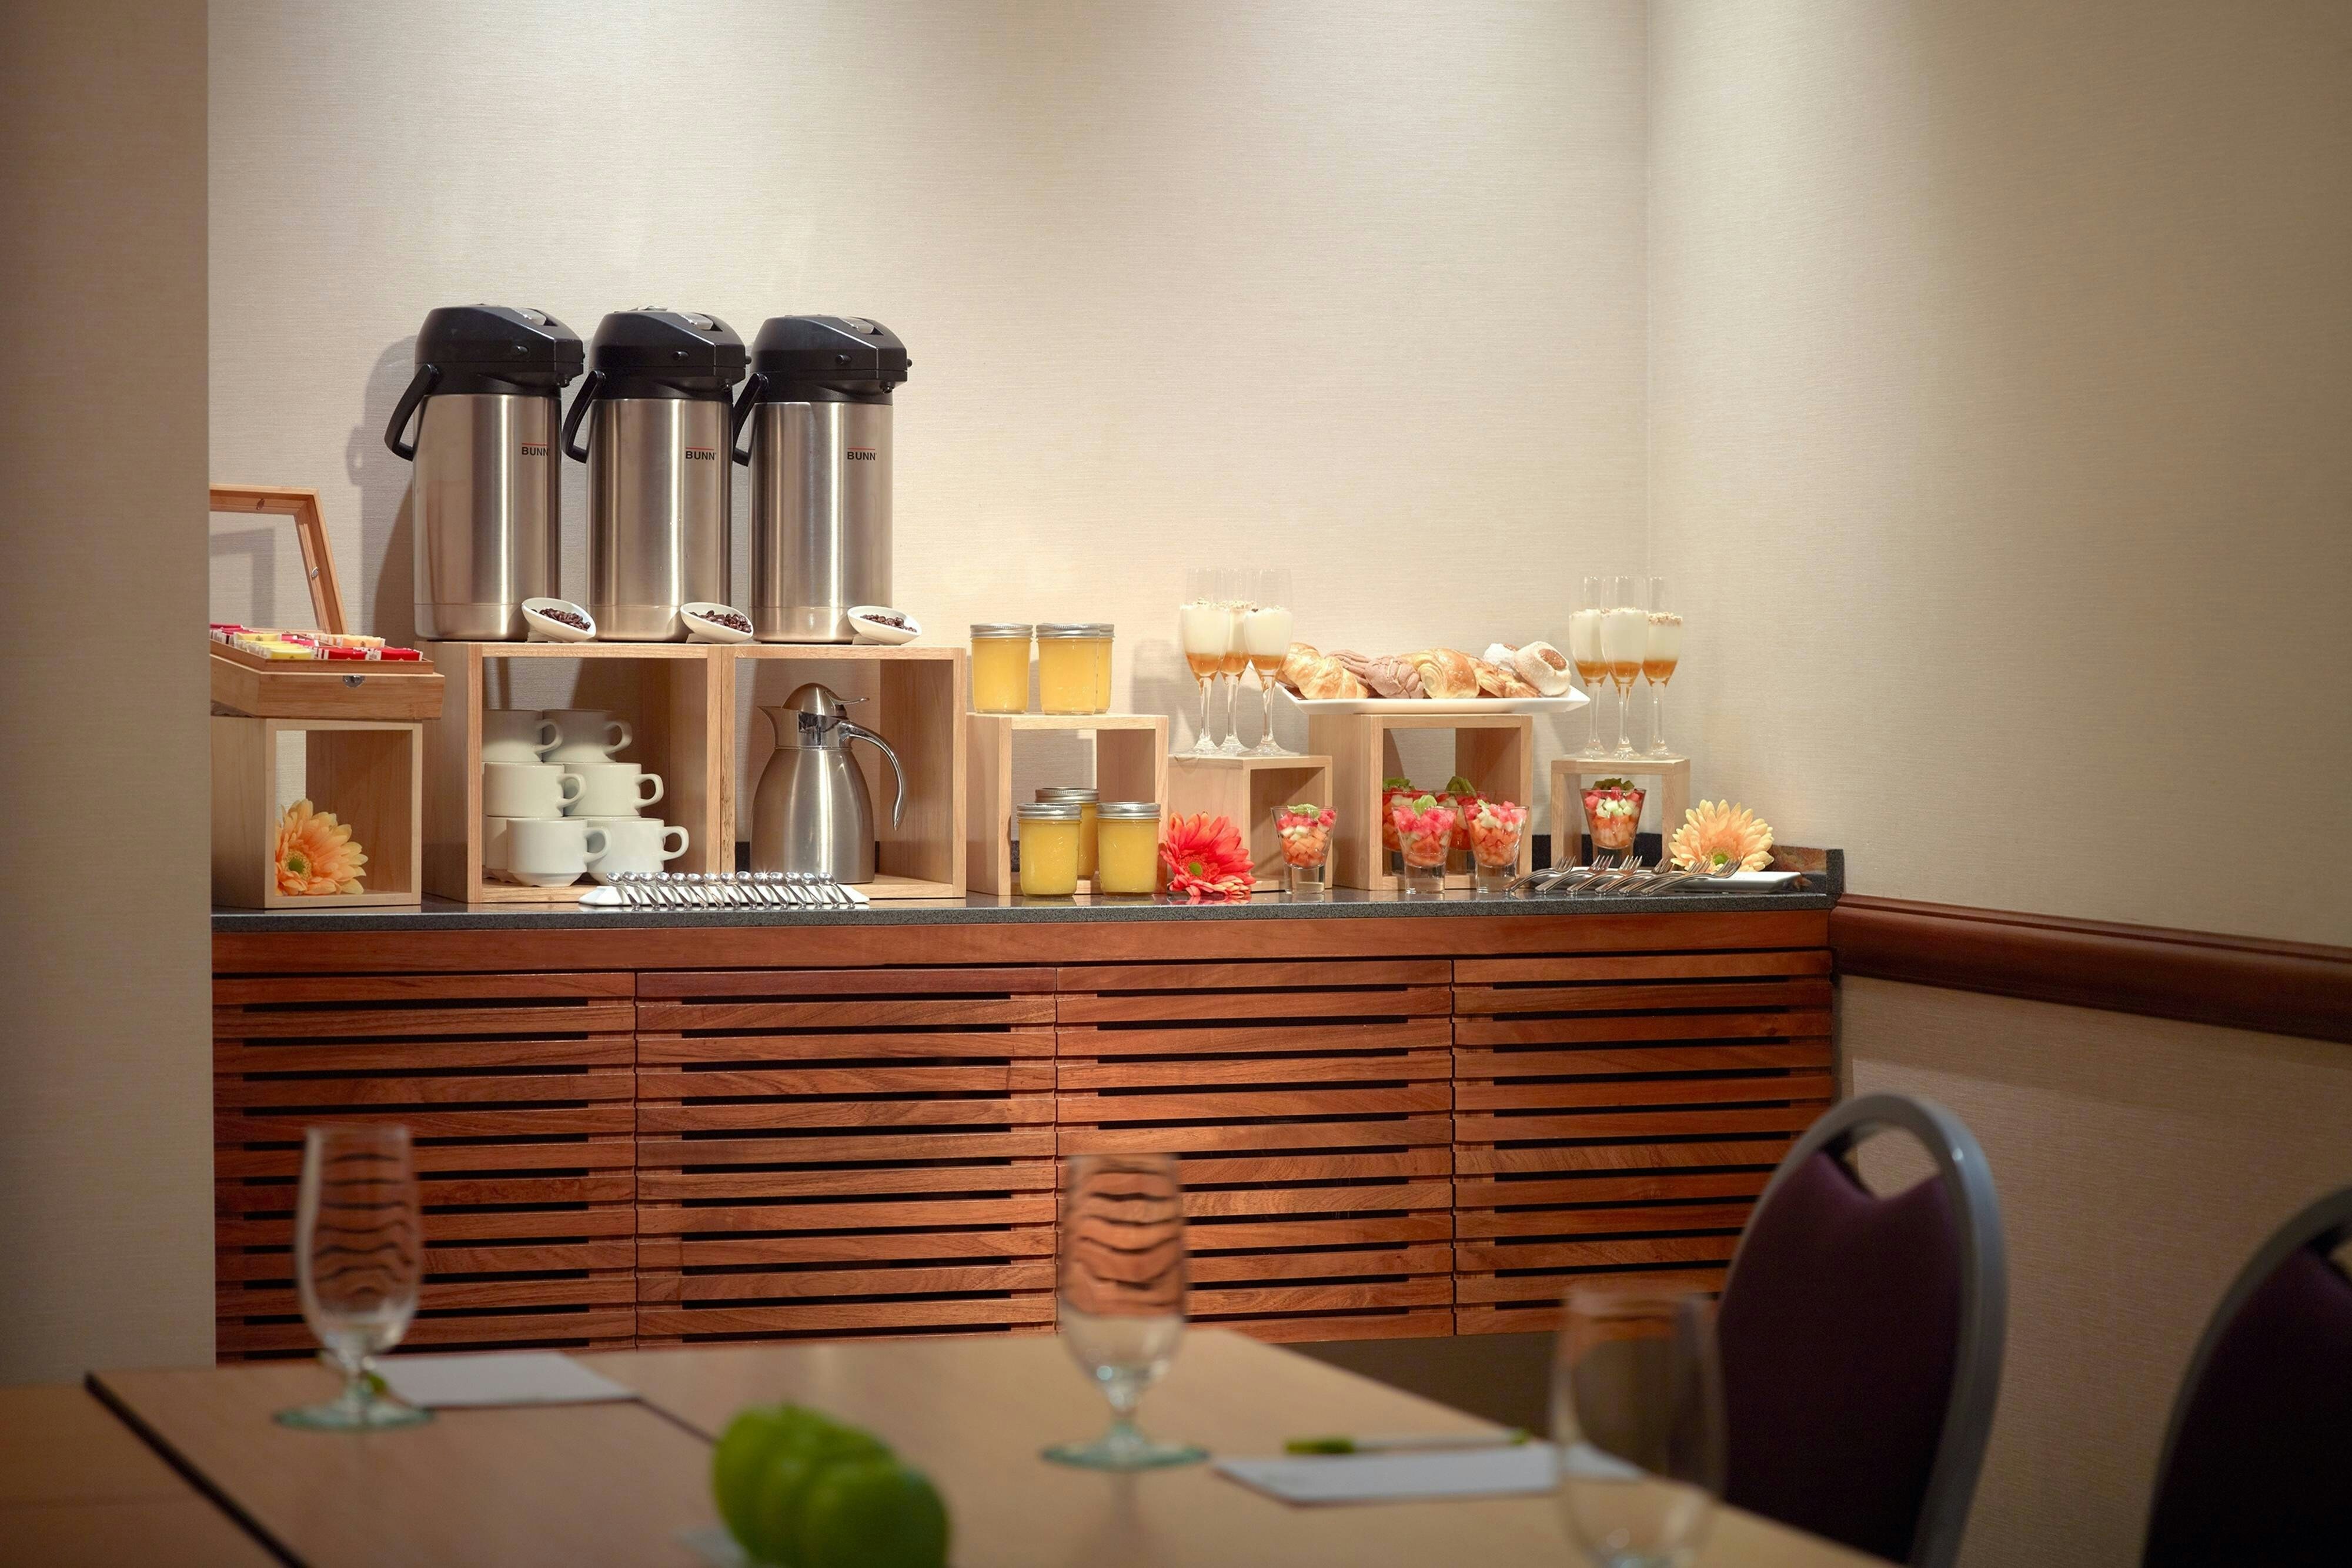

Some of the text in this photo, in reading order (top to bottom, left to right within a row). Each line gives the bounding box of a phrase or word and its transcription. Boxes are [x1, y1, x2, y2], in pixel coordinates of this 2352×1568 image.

[522, 446, 549, 456] BUNN
[686, 451, 714, 460] BUNN
[847, 452, 876, 460] BUNN
